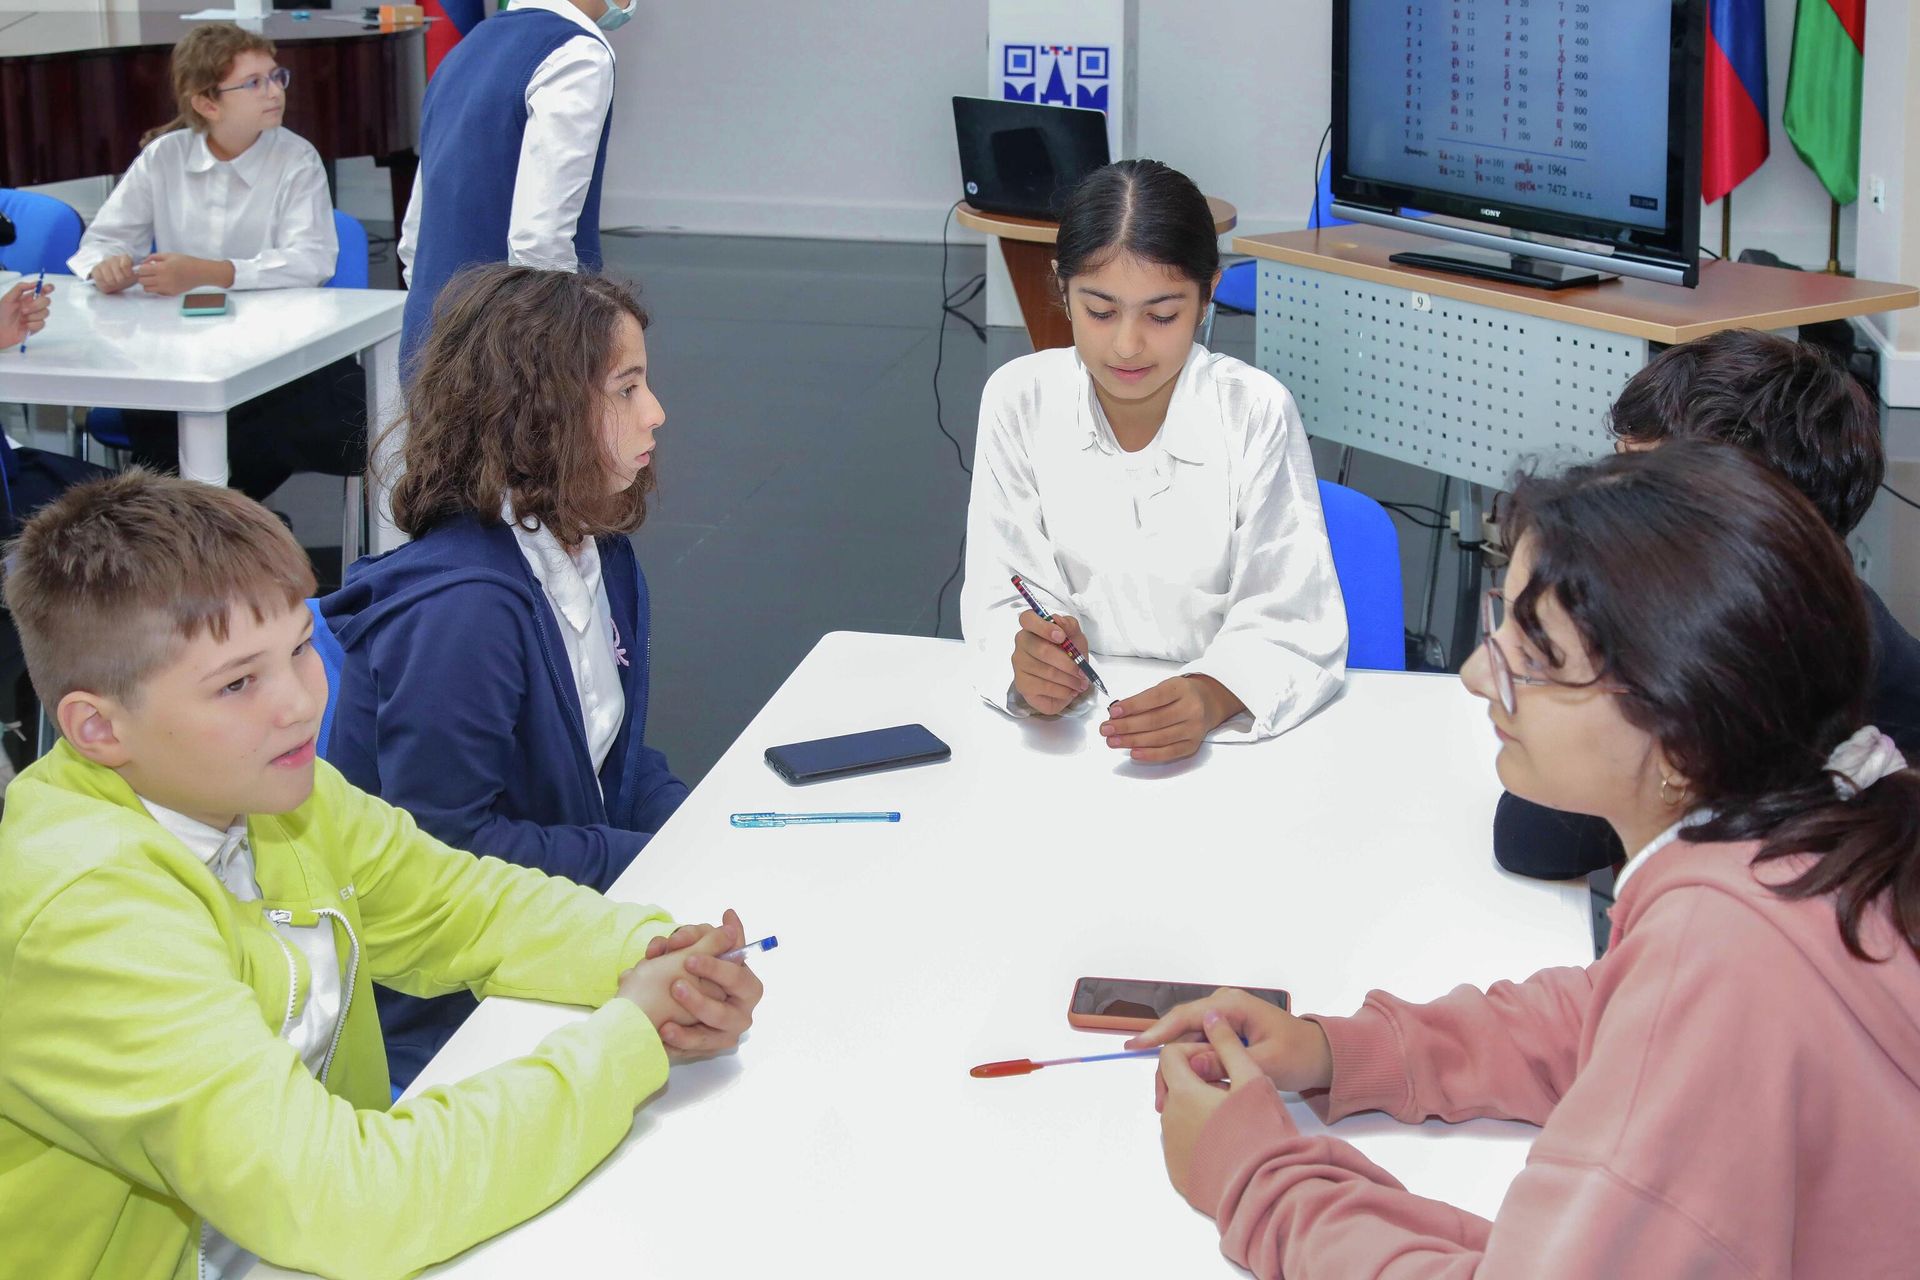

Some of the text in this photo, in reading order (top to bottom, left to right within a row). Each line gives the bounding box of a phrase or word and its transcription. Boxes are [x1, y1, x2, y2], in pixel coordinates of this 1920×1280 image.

[1575, 4, 1590, 14] 200
[1575, 21, 1589, 31] 300
[1520, 34, 1529, 43] 40
[1575, 37, 1589, 46] 400
[1575, 54, 1589, 64] 500
[1518, 67, 1528, 76] 60
[1574, 71, 1588, 80] 600
[1466, 76, 1474, 85] 16
[1519, 83, 1528, 93] 70
[1574, 88, 1588, 98] 700
[1466, 92, 1474, 101] 17
[1574, 106, 1588, 116] 800
[1466, 108, 1474, 117] 18
[1518, 117, 1527, 126] 90
[1573, 122, 1588, 132] 900
[1519, 132, 1531, 141] 100
[1570, 139, 1588, 150] 1000
[1548, 164, 1567, 176] 1964
[1547, 183, 1567, 197] 7472
[1481, 208, 1501, 218] SONY
[1417, 296, 1423, 308] 9
